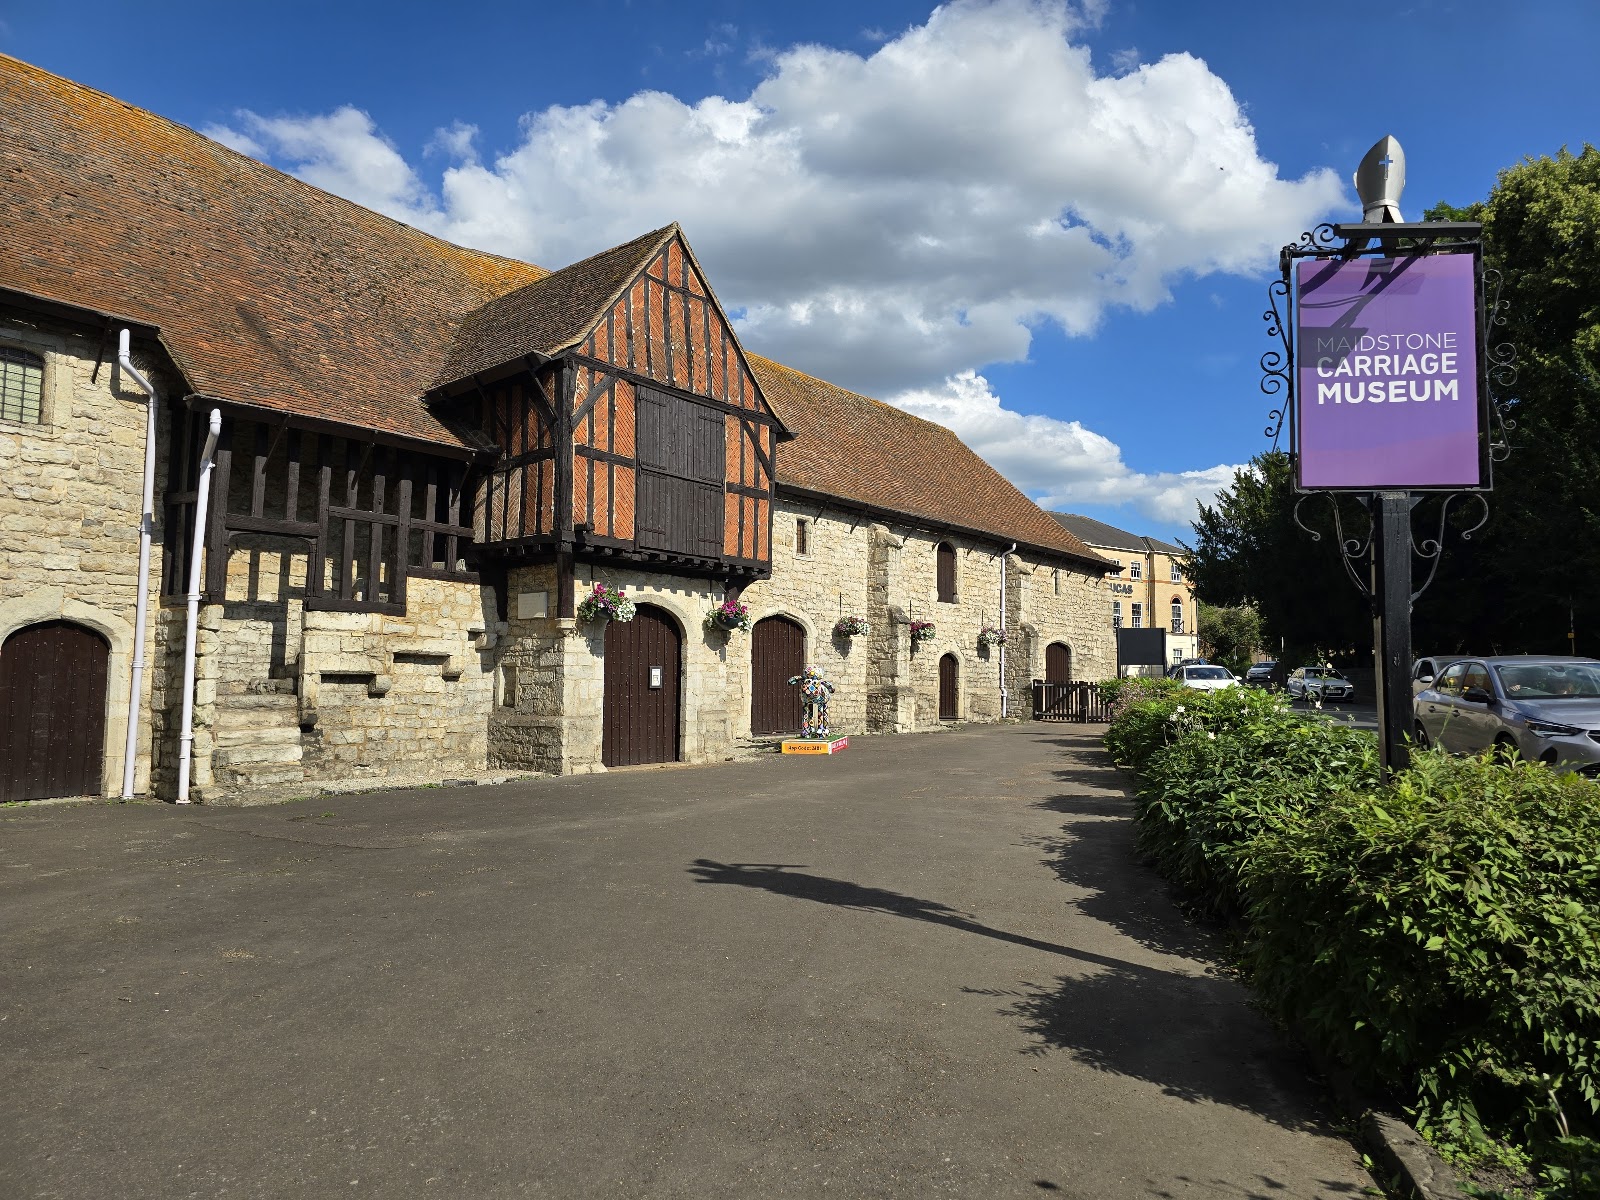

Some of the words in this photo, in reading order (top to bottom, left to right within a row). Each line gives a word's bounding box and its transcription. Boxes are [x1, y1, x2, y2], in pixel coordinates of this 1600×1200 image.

[1317, 332, 1457, 353] MAIDSTONE
[1316, 352, 1458, 378] CARRIAGE
[1317, 379, 1459, 405] MUSEUM
